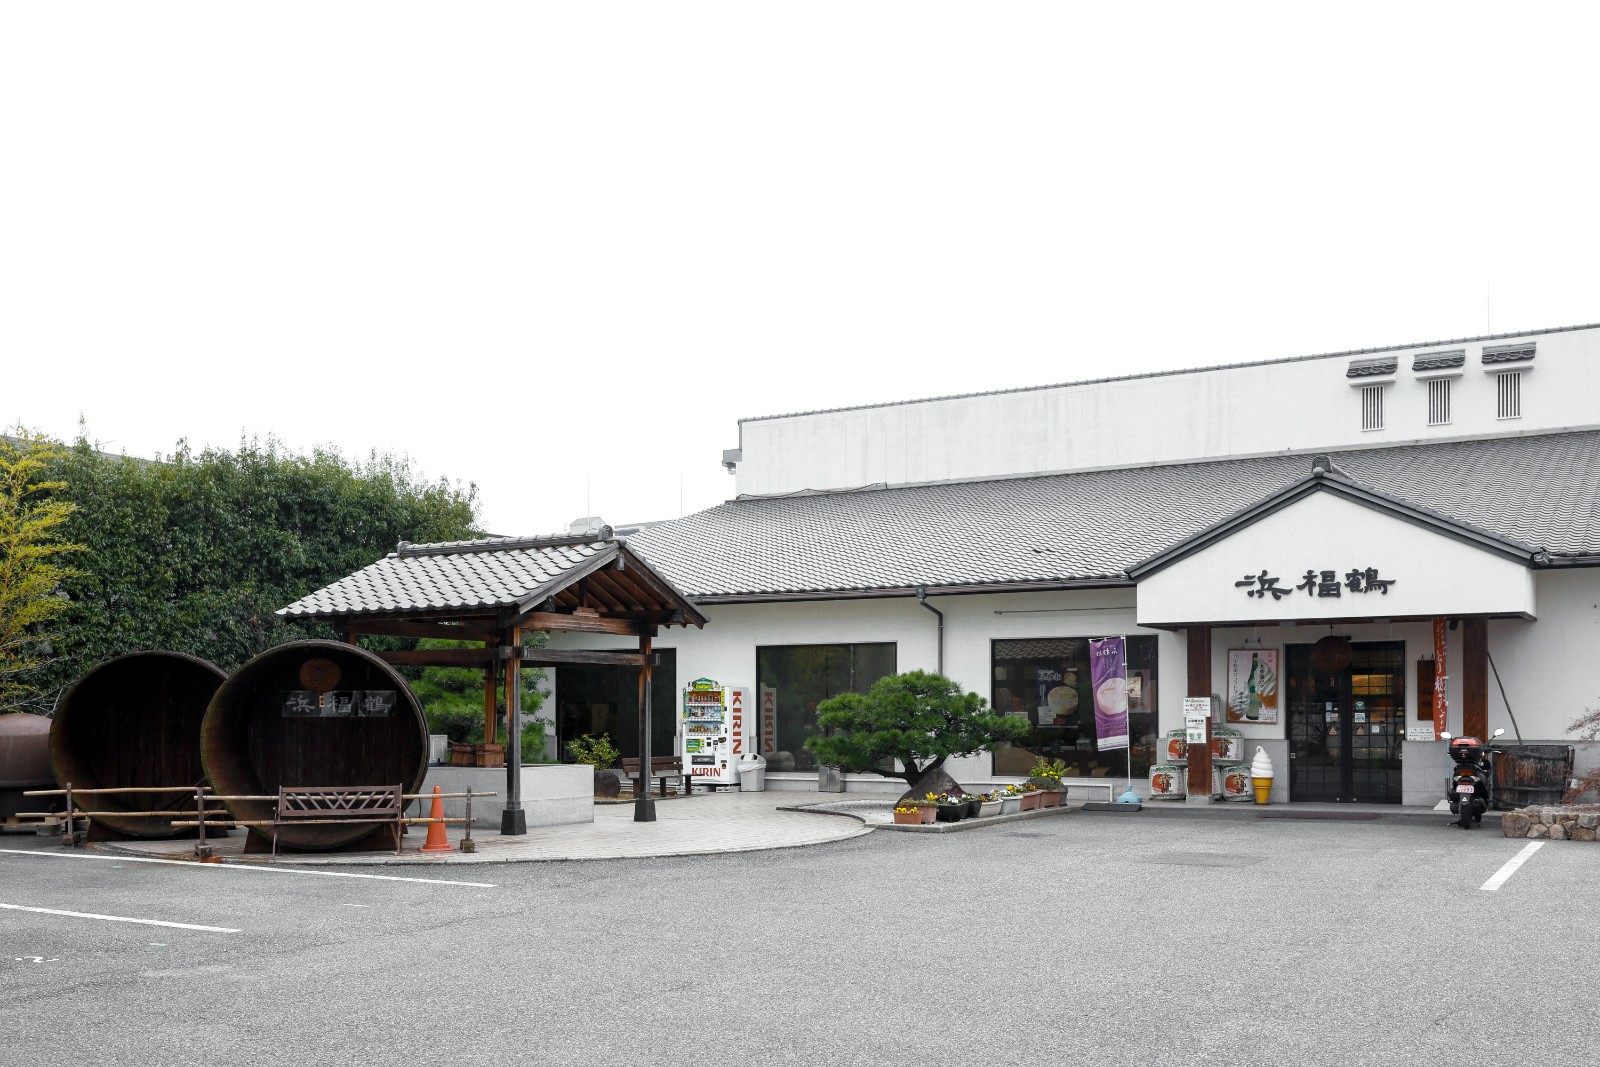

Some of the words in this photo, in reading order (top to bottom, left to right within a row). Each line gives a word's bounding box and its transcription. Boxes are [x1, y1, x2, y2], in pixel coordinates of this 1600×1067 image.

[1234, 566, 1397, 601] 浜福鶴
[285, 694, 393, 714] 浜福鶴
[732, 691, 742, 754] KIRIN
[691, 767, 721, 778] KIRIN
